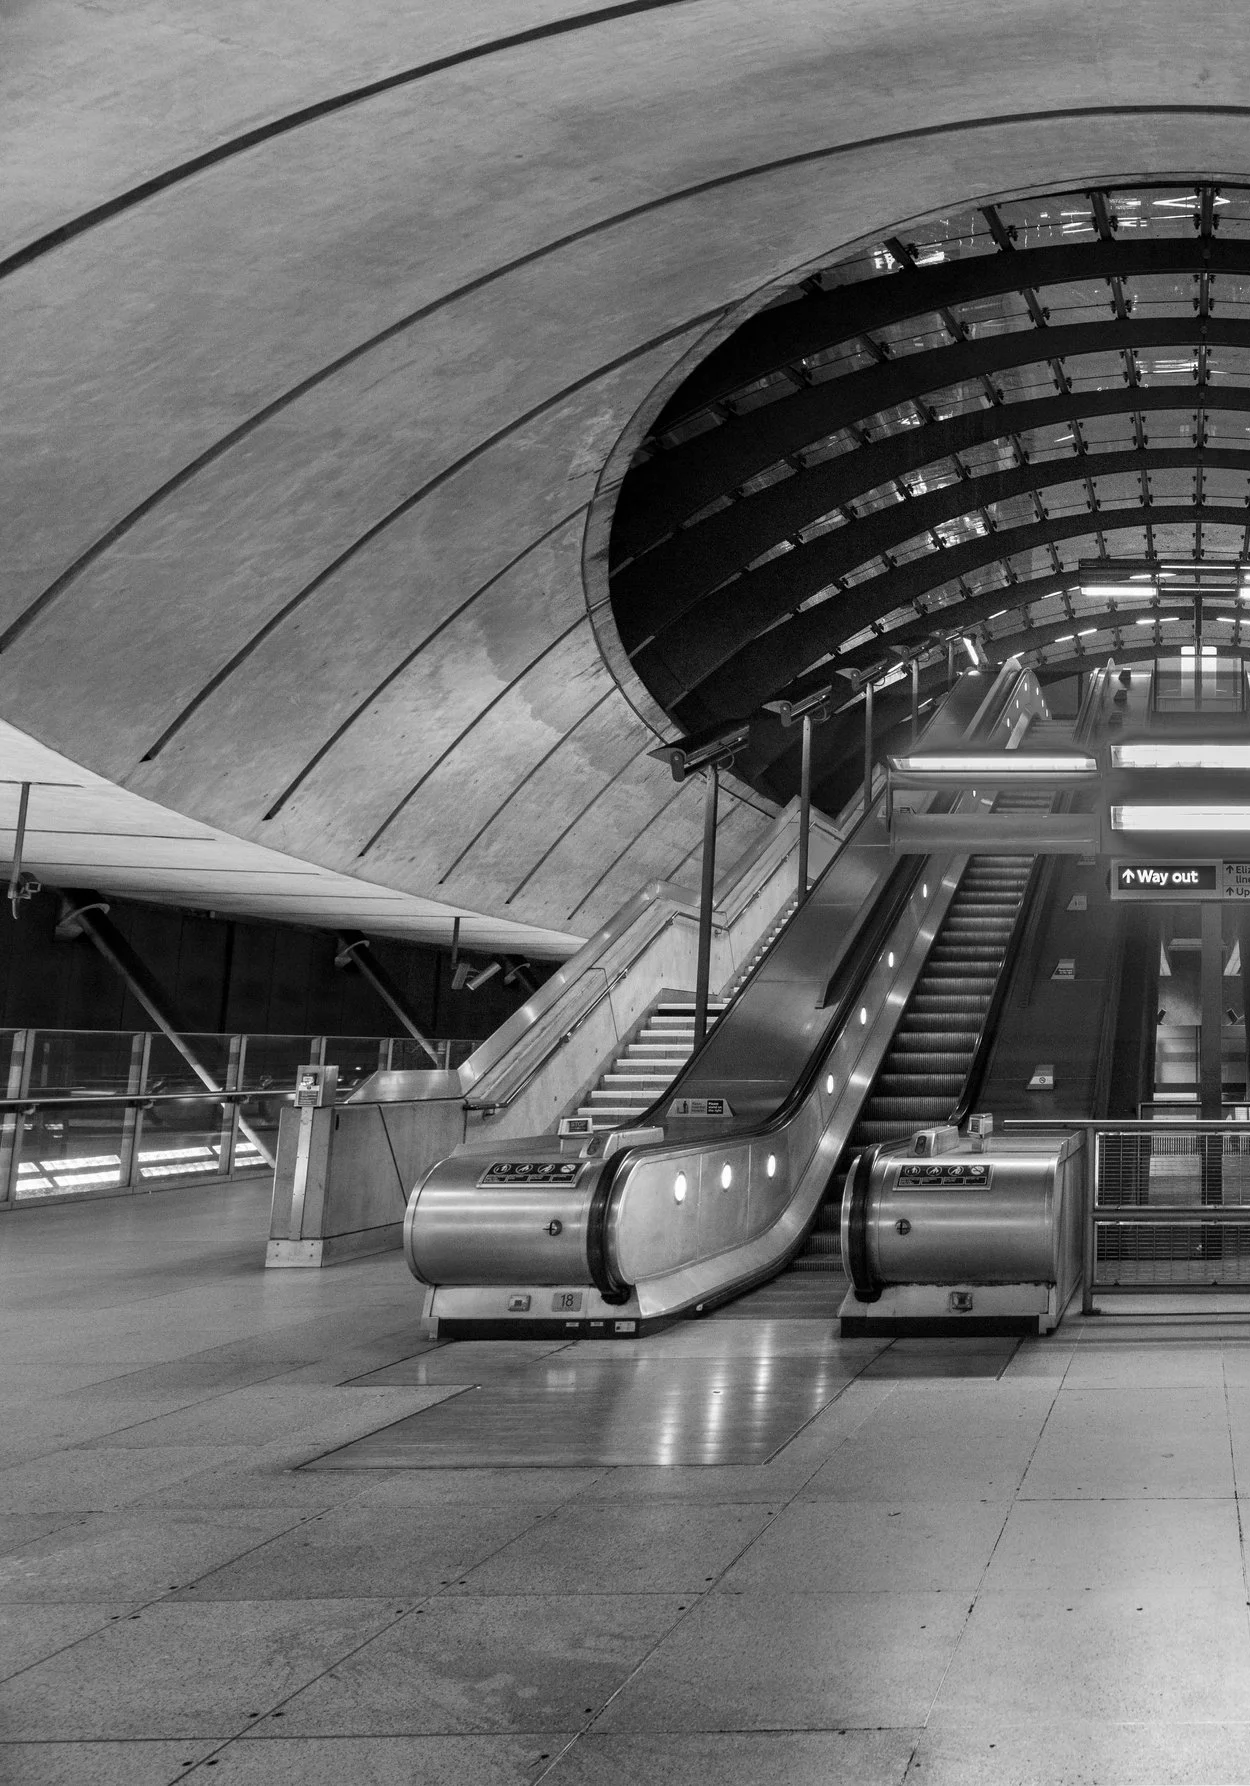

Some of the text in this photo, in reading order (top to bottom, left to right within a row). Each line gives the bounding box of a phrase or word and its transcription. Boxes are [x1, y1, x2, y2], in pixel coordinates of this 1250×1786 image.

[1136, 869, 1199, 886] Way out
[560, 1293, 574, 1307] 18
